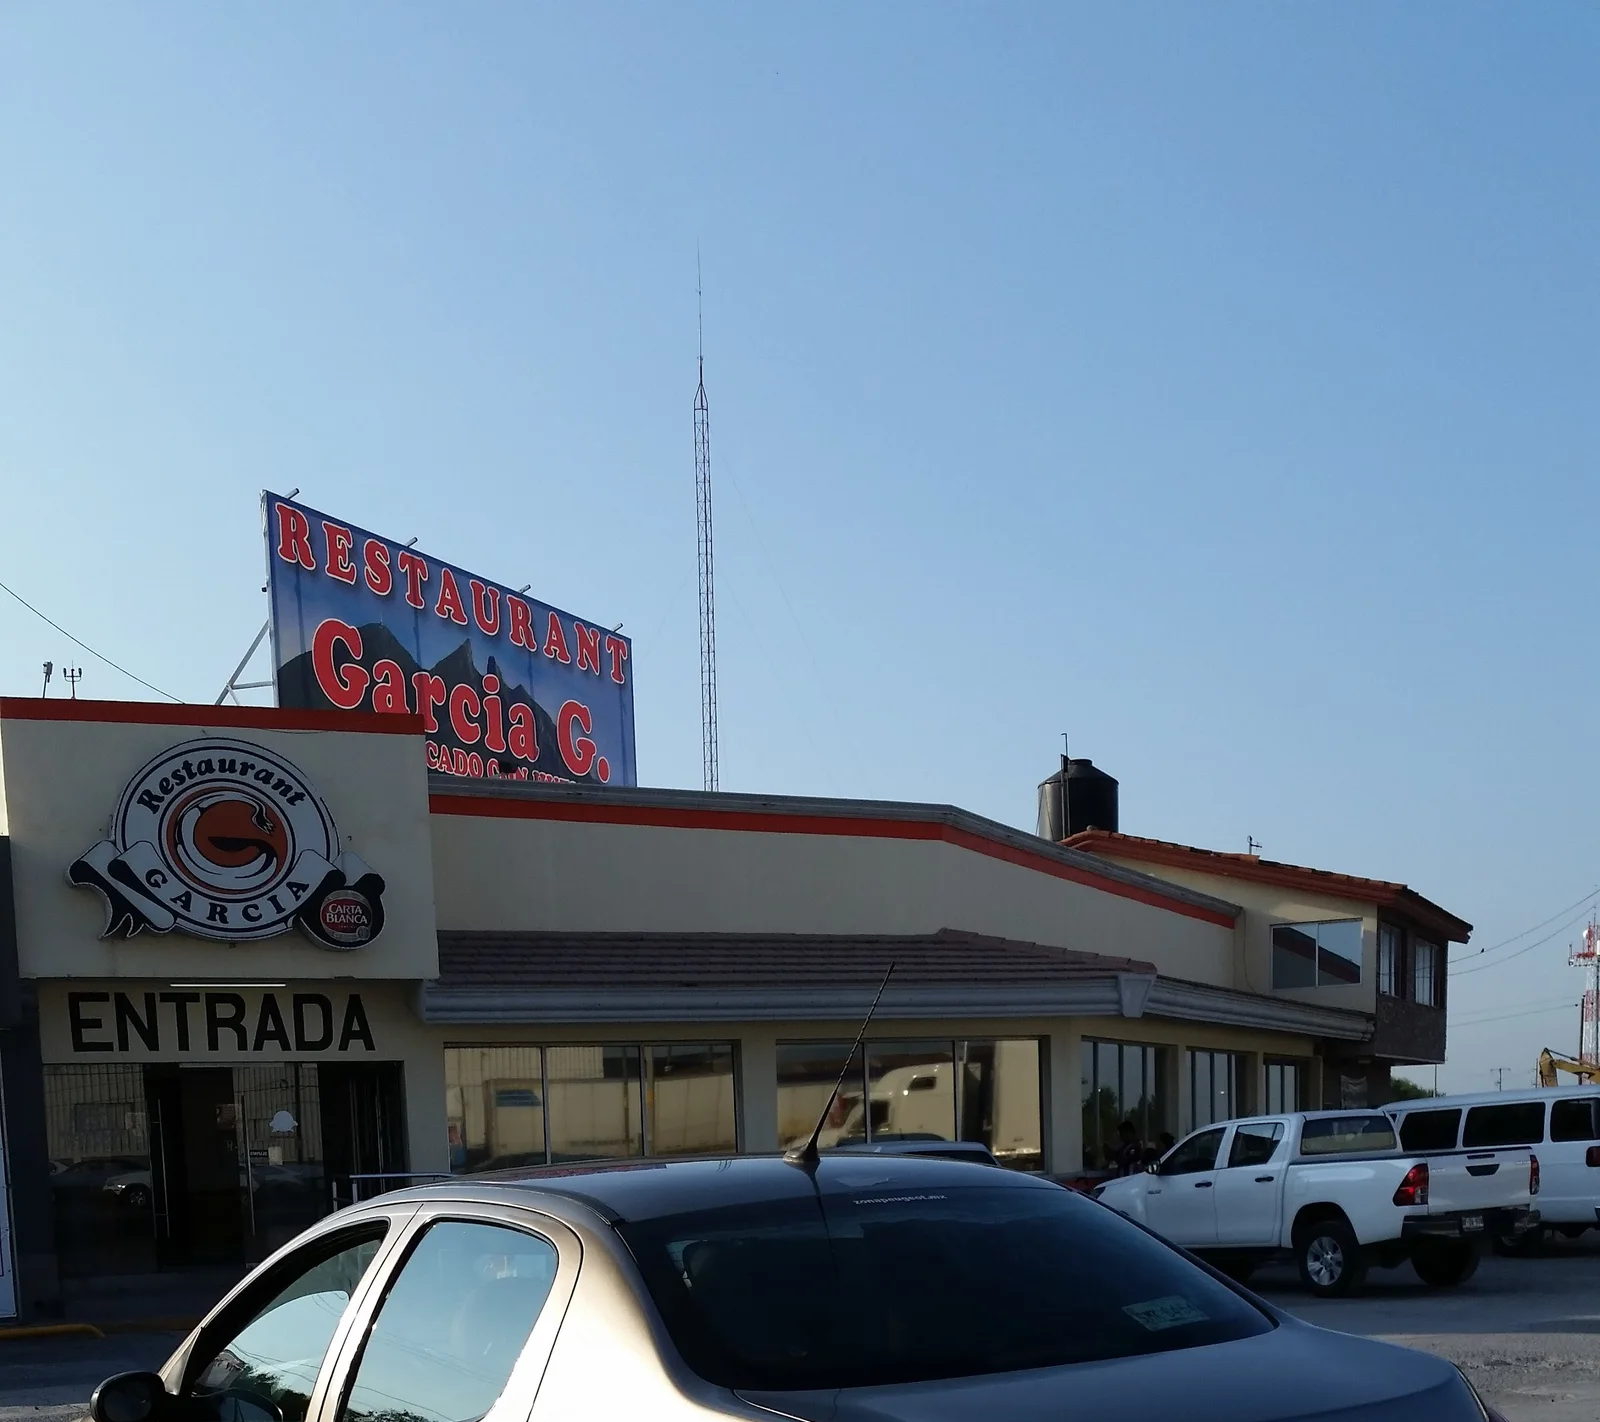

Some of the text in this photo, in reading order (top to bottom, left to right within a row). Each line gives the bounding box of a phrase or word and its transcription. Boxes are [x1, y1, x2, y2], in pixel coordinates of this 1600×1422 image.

[274, 502, 628, 684] RESTAURANT
[312, 618, 610, 783] Garcia G.
[136, 756, 306, 815] Restaurant
[145, 868, 310, 924] GARCIA
[326, 912, 368, 924] BLANCA
[328, 903, 363, 915] CARTA
[67, 992, 377, 1053] ENTRADA
